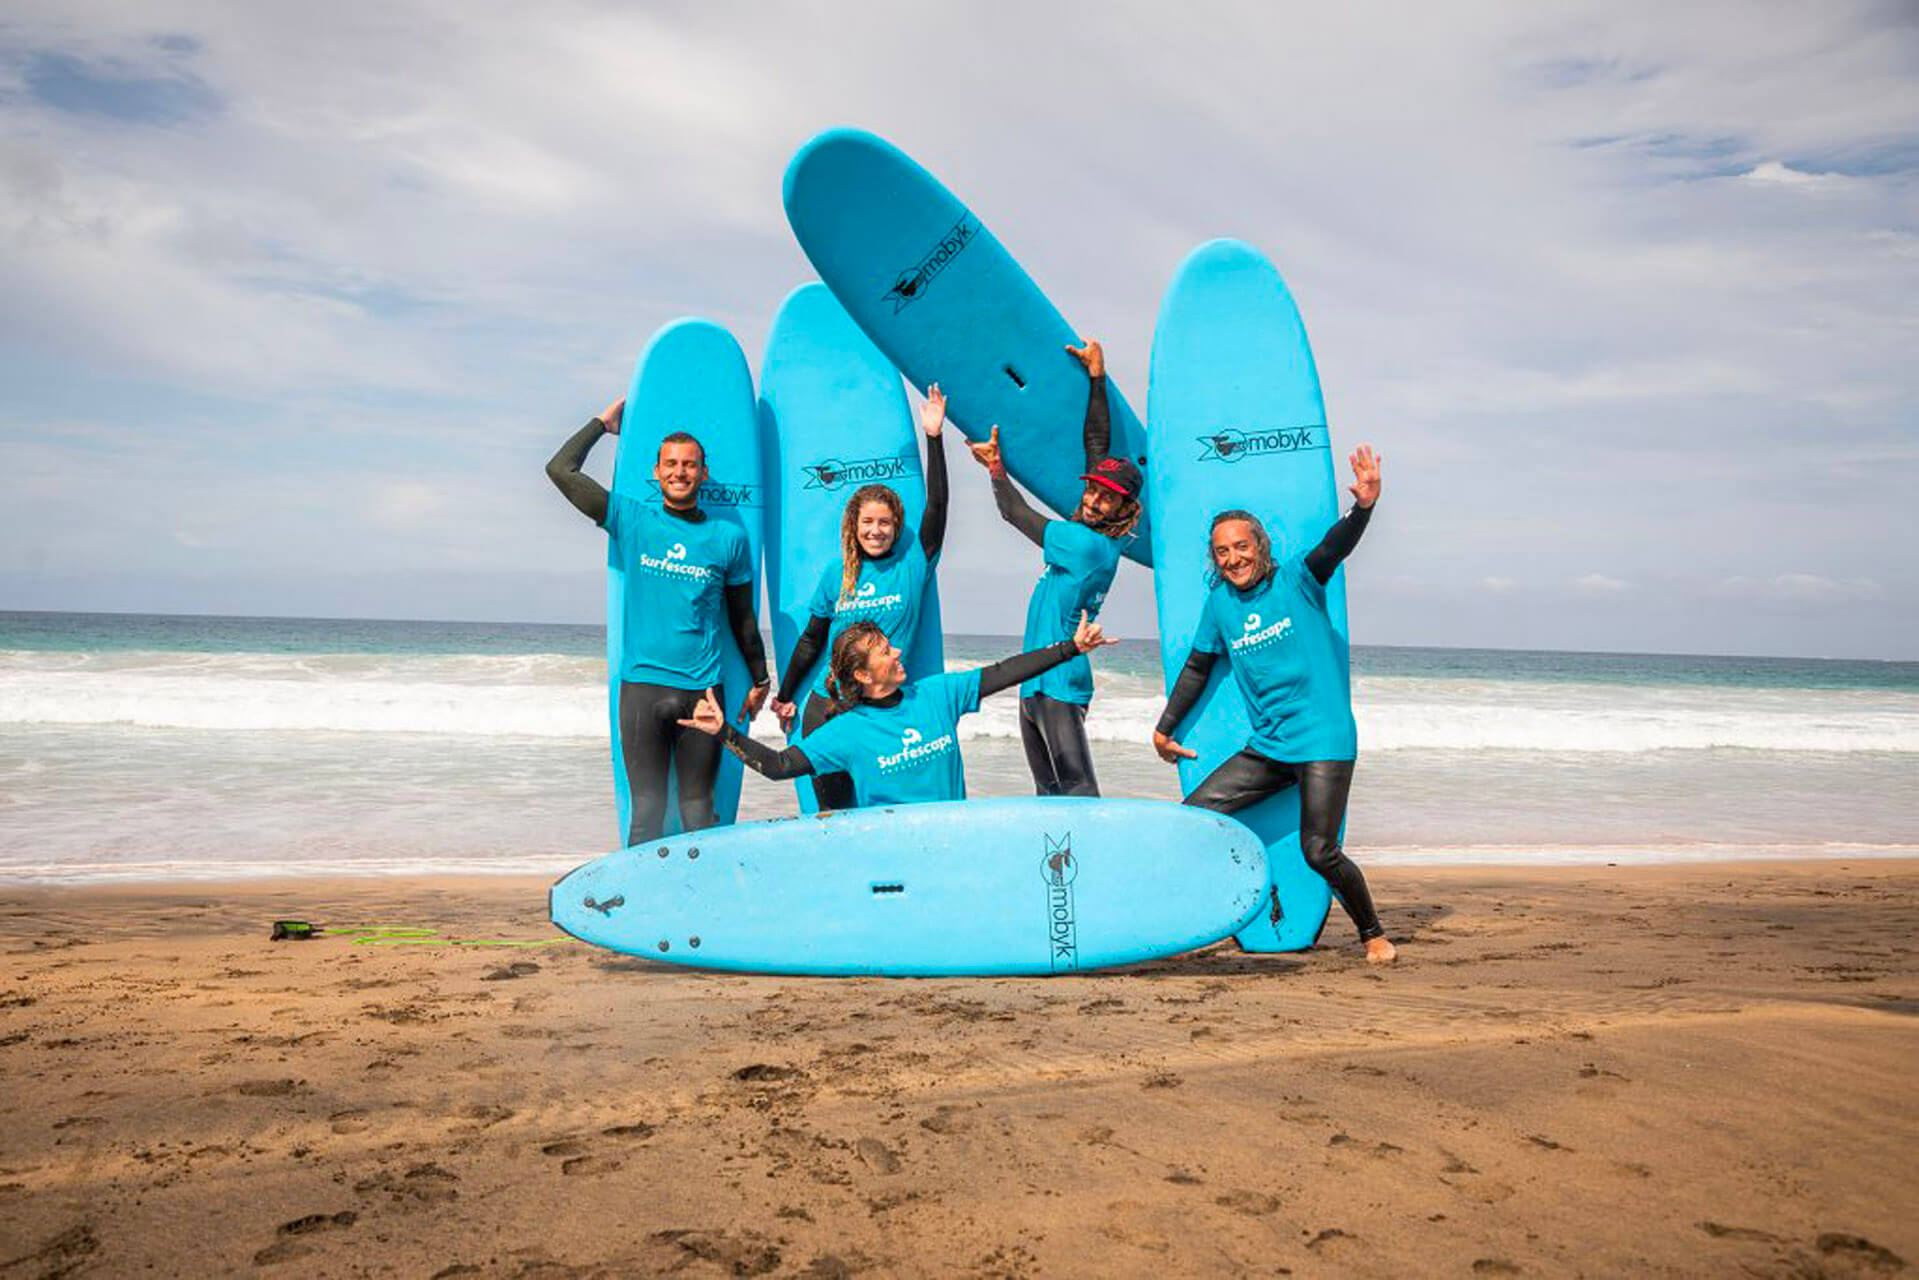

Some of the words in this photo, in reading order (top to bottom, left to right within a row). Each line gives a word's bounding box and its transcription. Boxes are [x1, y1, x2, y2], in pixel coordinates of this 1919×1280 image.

[922, 223, 972, 277] mobyk
[1248, 427, 1312, 451] mobyk
[847, 457, 906, 480] mobyk
[640, 553, 711, 578] Surfescape
[1052, 887, 1076, 958] mobyk
